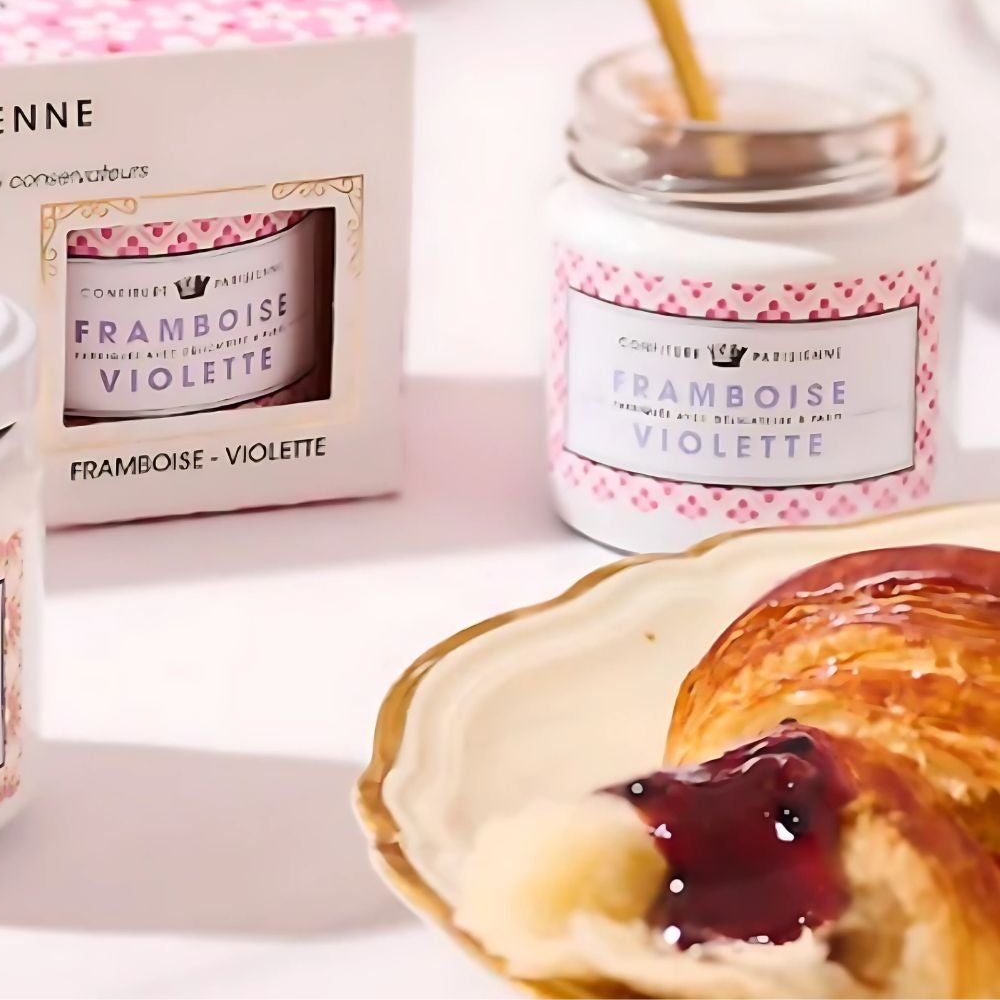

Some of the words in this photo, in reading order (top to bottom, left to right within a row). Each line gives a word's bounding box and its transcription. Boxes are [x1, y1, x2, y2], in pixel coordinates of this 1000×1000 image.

[74, 292, 288, 344] FRAMBOISE
[99, 346, 273, 393] VIOLETTE
[614, 370, 845, 408] FRAMBOISE
[70, 449, 204, 481] FRAMBOISE
[225, 436, 327, 465] VIOLETTE
[632, 422, 824, 459] VIOLETTE
